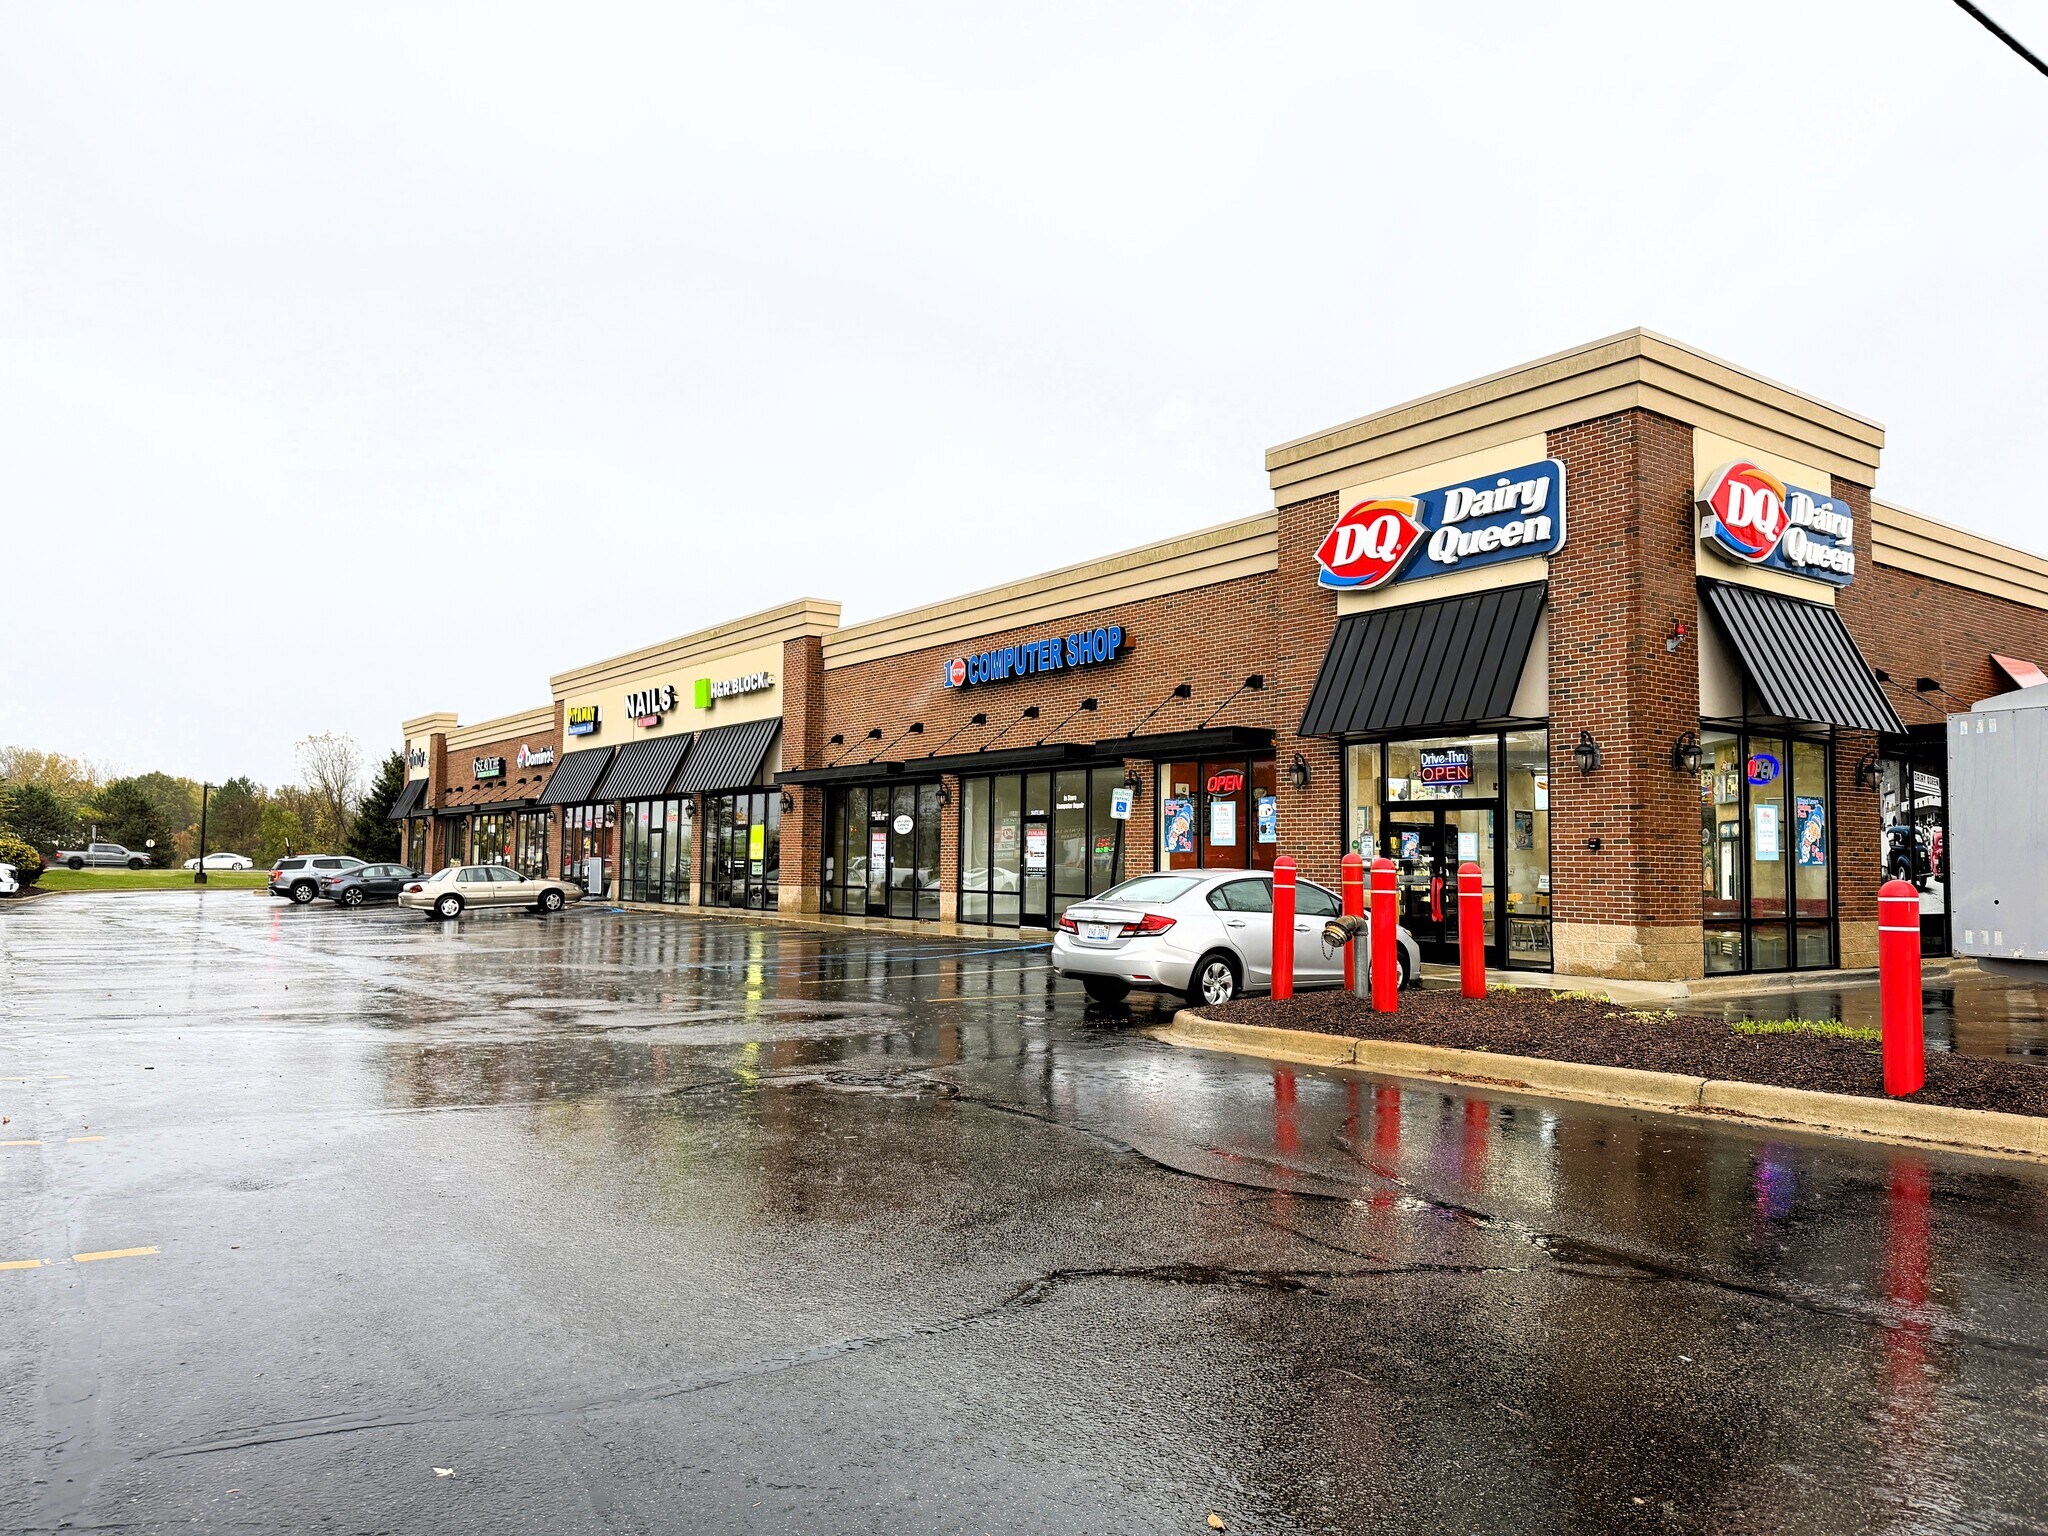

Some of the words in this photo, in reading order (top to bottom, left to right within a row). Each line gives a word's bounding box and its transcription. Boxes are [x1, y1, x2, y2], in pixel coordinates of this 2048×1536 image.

[1441, 476, 1550, 525] Dairy
[1726, 479, 1780, 542] DQ
[1790, 491, 1854, 546] Dairy
[1331, 514, 1402, 568] DQ
[1427, 514, 1551, 564] Queen
[1782, 527, 1855, 576] Queen
[968, 637, 1063, 685] COMPUTER
[1066, 625, 1121, 667] SHOP
[624, 684, 672, 719] NAILS
[711, 679, 730, 699] H&R
[731, 671, 769, 695] BLOCK
[525, 745, 554, 767] Domino's
[1421, 751, 1469, 766] Drive-Thru
[1421, 766, 1470, 781] OPEN
[1747, 759, 1775, 780] OPEN
[1207, 774, 1244, 792] OPEN
[1927, 775, 1939, 787] QUEEN
